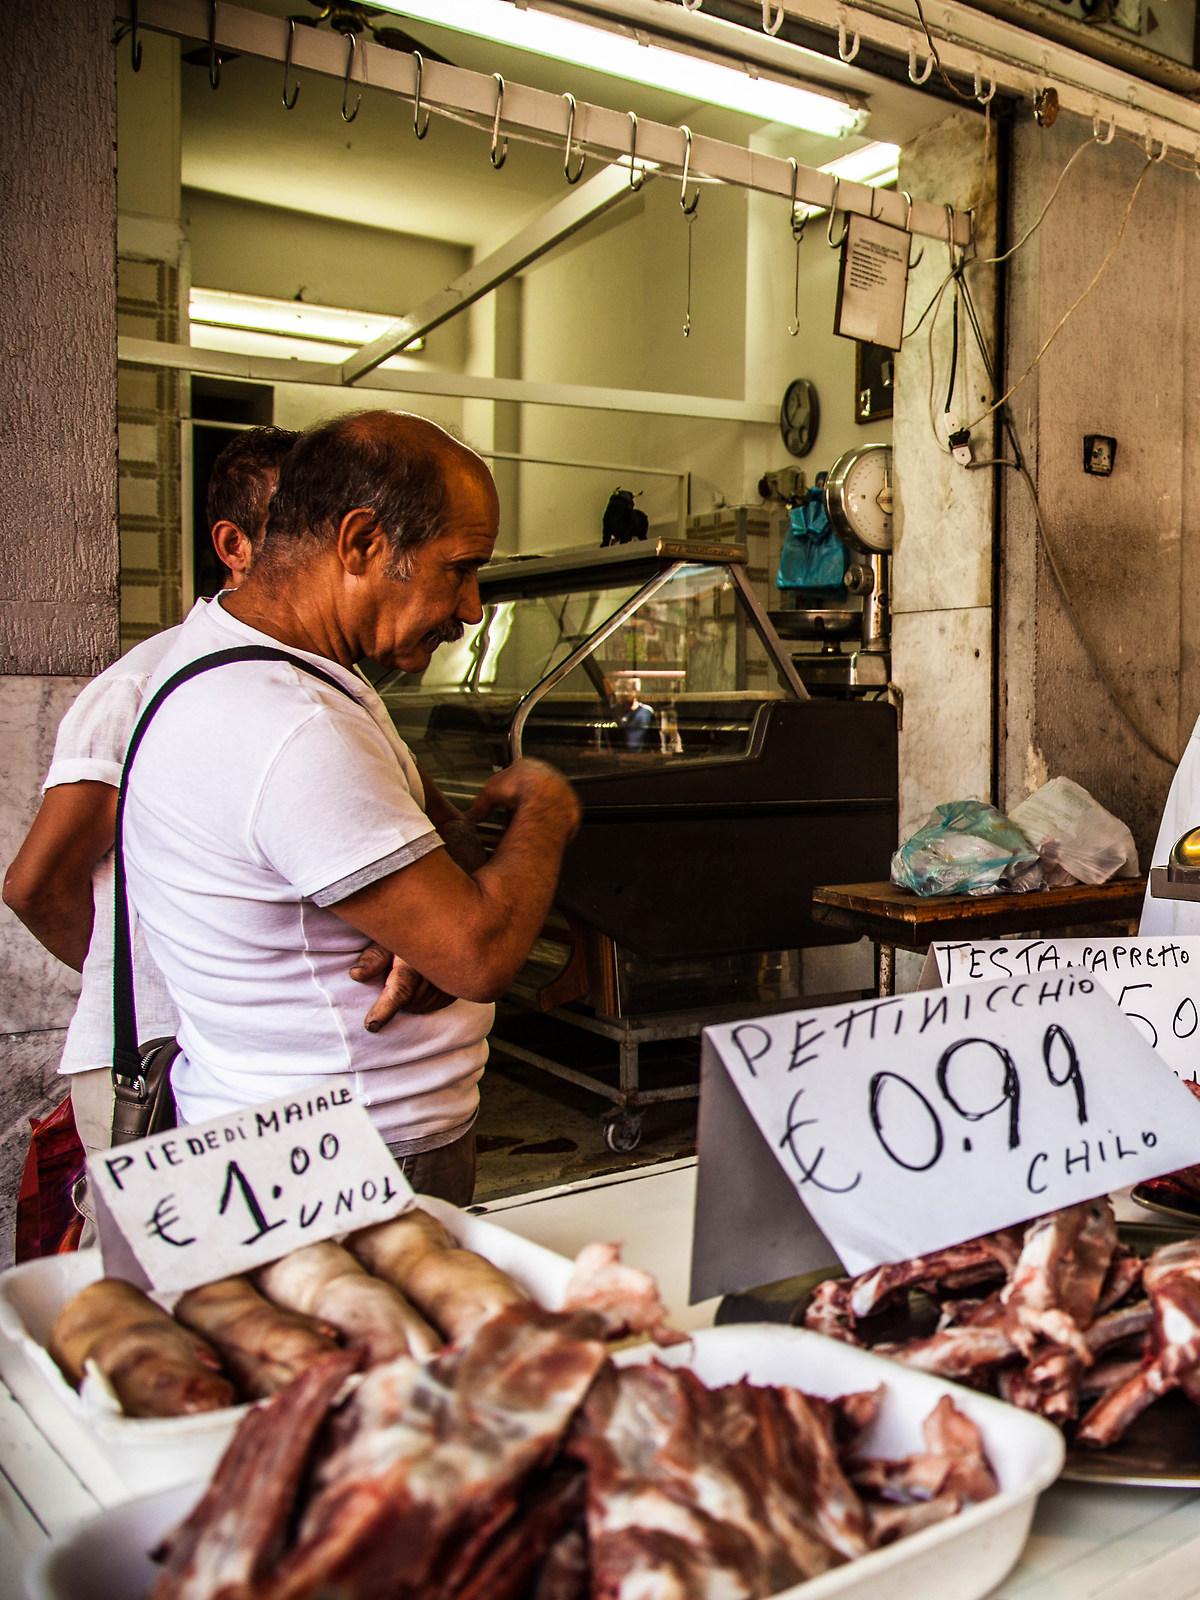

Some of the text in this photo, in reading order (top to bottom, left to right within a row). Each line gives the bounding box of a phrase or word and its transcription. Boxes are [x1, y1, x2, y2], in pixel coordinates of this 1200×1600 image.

[936, 941, 1060, 985] TESTA
[780, 1023, 1089, 1193] € 0.99
[218, 1132, 340, 1246] 1.00
[1026, 1129, 1158, 1194] CHILO
